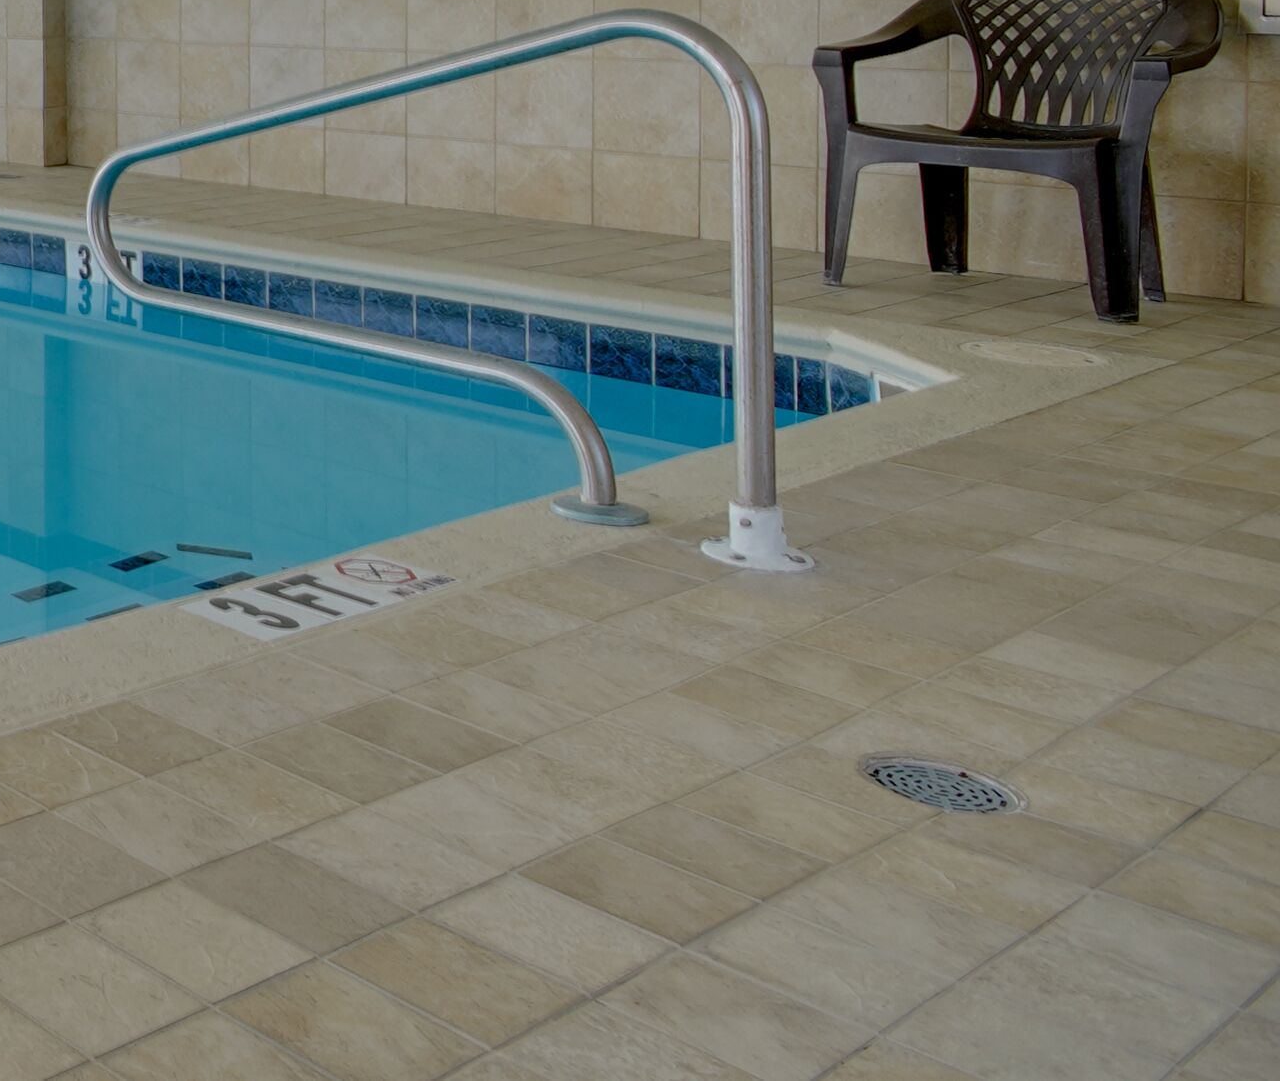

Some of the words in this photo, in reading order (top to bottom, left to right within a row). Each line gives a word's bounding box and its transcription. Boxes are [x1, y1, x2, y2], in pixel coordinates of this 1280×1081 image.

[78, 244, 92, 279] 3
[208, 597, 300, 629] 3
[256, 573, 378, 617] FT
